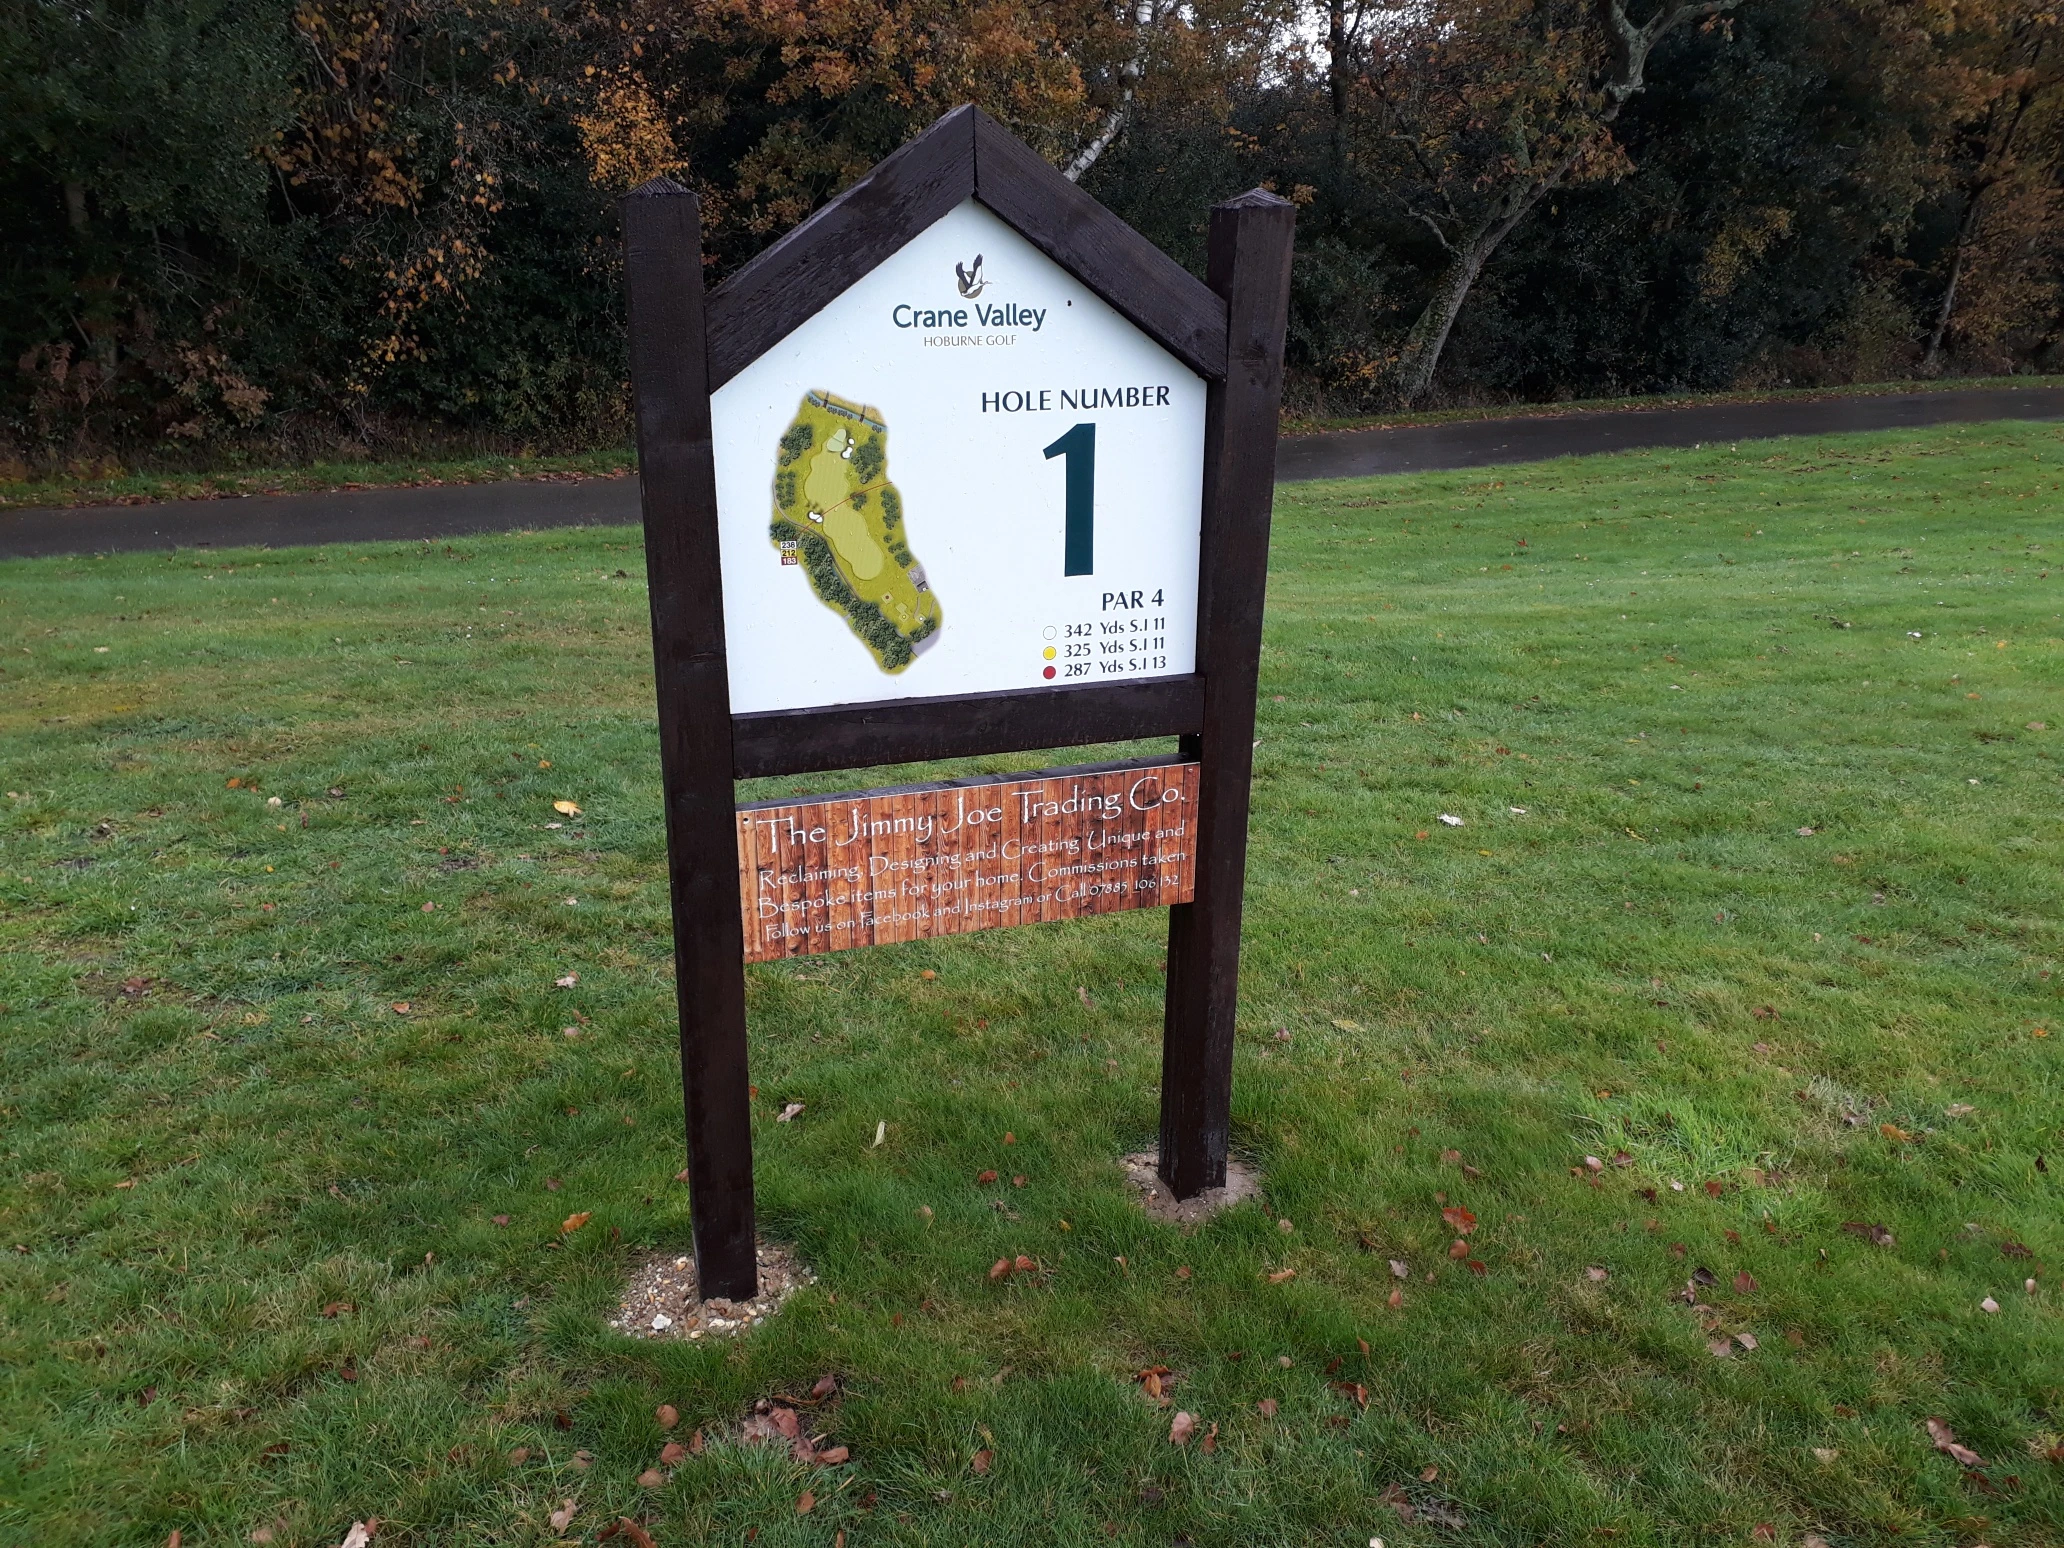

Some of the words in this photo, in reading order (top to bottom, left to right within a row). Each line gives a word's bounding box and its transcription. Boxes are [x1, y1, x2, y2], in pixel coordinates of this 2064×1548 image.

[892, 303, 968, 328] Crane
[974, 303, 1047, 332] Valley
[923, 335, 983, 347] HOBURNE
[985, 334, 1017, 346] GOLF
[981, 389, 1052, 413] HOLE
[1060, 385, 1171, 411] NUMBER
[1042, 422, 1096, 577] 1
[781, 541, 796, 549] 238
[781, 549, 796, 557] 212
[782, 557, 797, 565] 183
[1102, 590, 1144, 611] PAR
[1151, 588, 1165, 607] 4
[1063, 623, 1093, 638] 342
[1099, 620, 1125, 635] Yds
[1153, 617, 1165, 630] 11
[1063, 643, 1092, 658] 325
[1099, 640, 1125, 654] Yds
[1153, 636, 1165, 650] 11
[1064, 662, 1092, 677] 287
[1099, 659, 1124, 674] Yds
[1152, 656, 1167, 669] 13
[756, 816, 827, 854] The
[835, 808, 933, 847] Jimmy
[940, 796, 1003, 834] Joe
[1011, 784, 1122, 824] Trading
[1129, 776, 1187, 811] Co.
[868, 852, 962, 878] Designing
[965, 842, 997, 862] and
[1001, 838, 1080, 860] Creating
[1087, 829, 1151, 851] Unique
[1155, 820, 1186, 839] and
[758, 890, 847, 919] Bespoke
[850, 886, 897, 908] items
[901, 879, 927, 897] for
[931, 879, 971, 900] your
[975, 870, 1024, 888] home.
[1028, 858, 1138, 883] Commissions
[1141, 848, 1187, 866] taken
[765, 923, 811, 942] Follow
[815, 922, 832, 934] us
[836, 919, 856, 931] on
[859, 904, 930, 929] Facebook
[933, 900, 961, 917] and
[965, 894, 1033, 915] Instagram
[1036, 892, 1053, 904] or
[1055, 883, 1087, 903] Call
